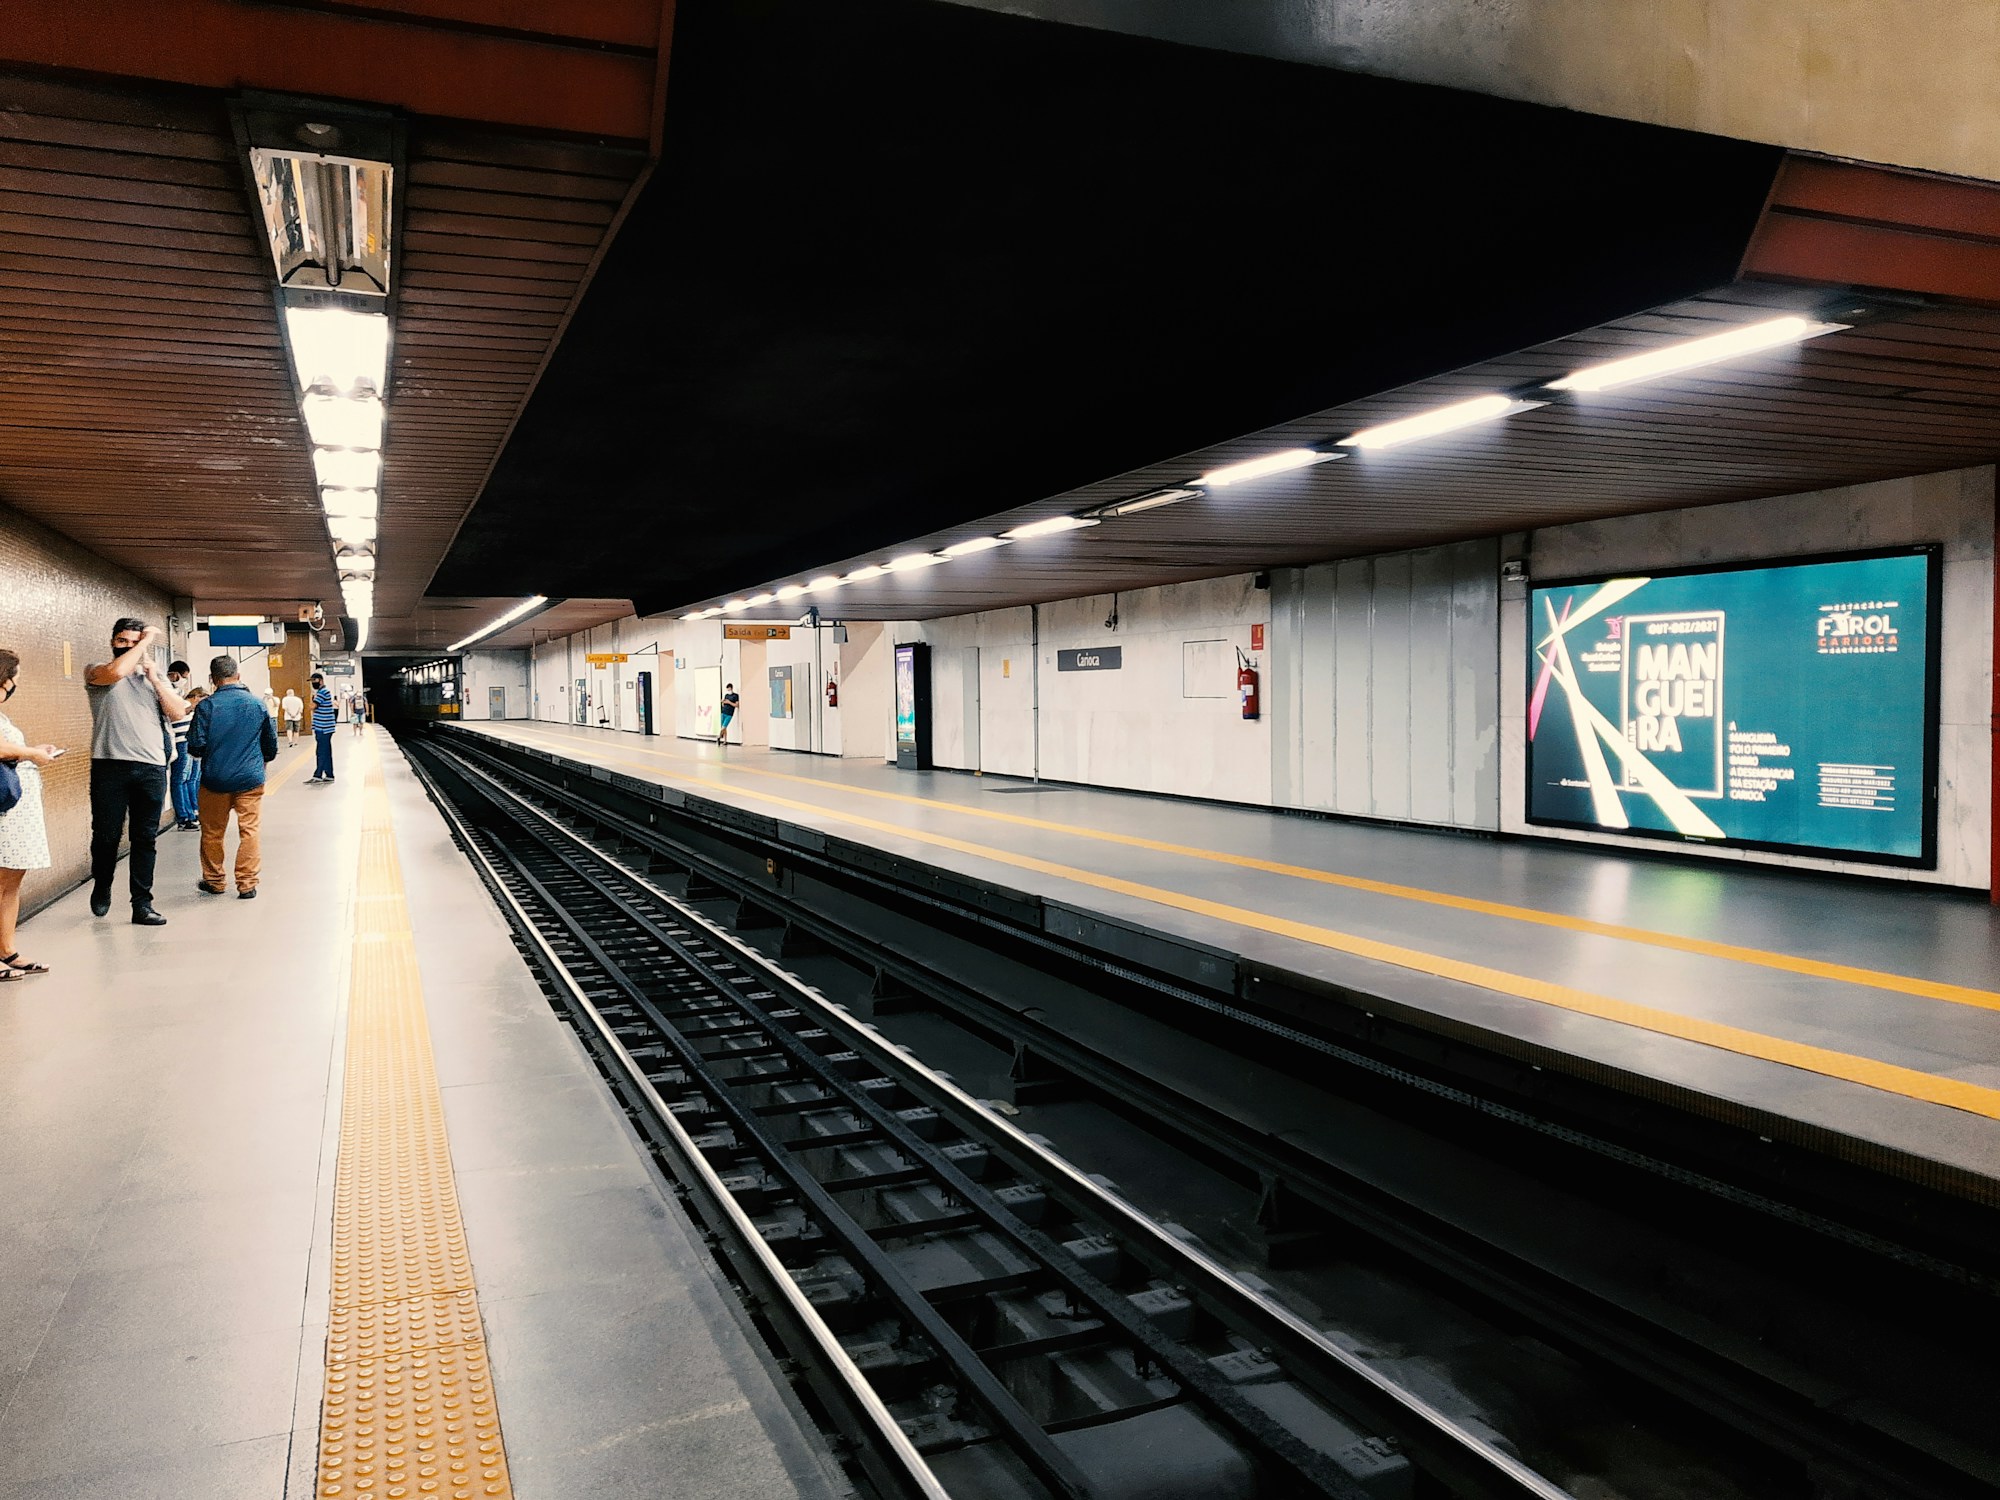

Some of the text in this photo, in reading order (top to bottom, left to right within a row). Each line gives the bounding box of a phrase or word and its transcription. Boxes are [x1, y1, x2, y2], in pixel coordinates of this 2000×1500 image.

[729, 628, 751, 636] Saída
[1818, 636, 1898, 647] CARIOCA
[1077, 652, 1100, 667] Carioca
[1636, 643, 1717, 680] MAN
[1635, 679, 1714, 718] GUEI
[1729, 720, 1737, 731] A
[1636, 715, 1683, 752] RA
[1729, 732, 1777, 743] MANGUEIRA
[1729, 744, 1743, 755] FOI
[1744, 744, 1752, 755] O
[1742, 779, 1777, 791] ESTAÇÃO
